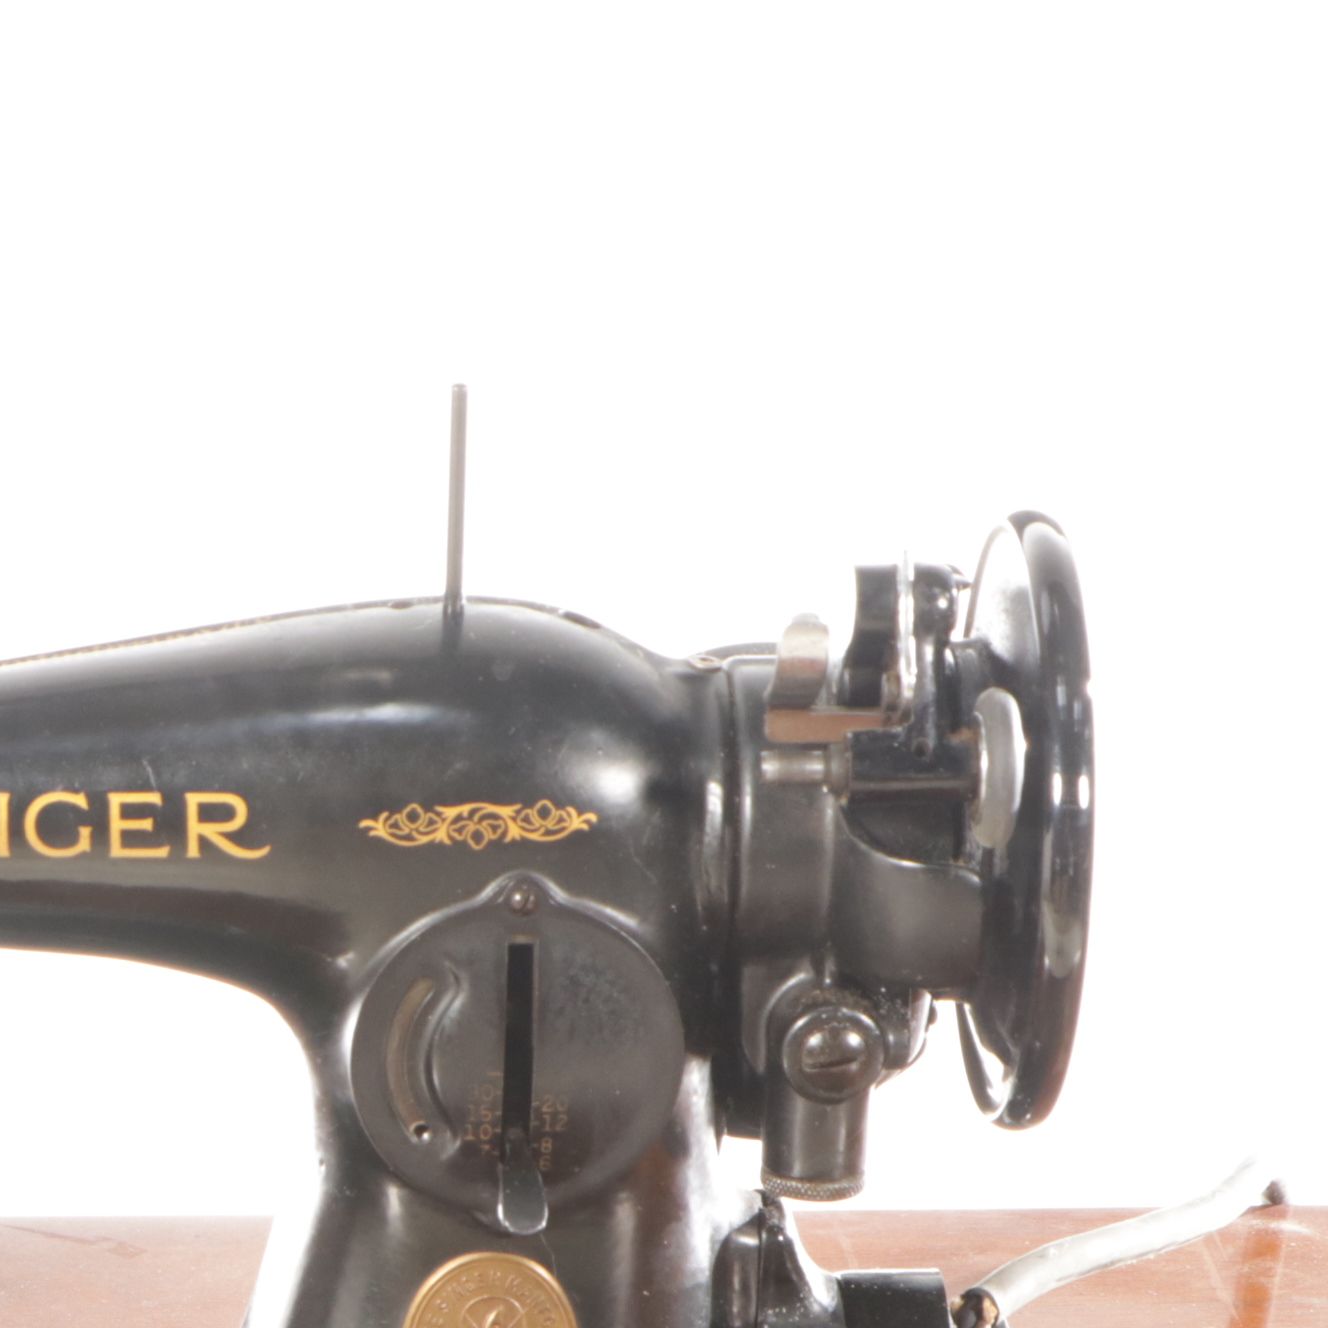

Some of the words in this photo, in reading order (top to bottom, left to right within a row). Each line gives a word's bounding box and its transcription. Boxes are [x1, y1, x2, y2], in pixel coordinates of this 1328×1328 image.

[542, 1114, 568, 1131] 12
[463, 1124, 493, 1140] 10
[540, 1137, 553, 1153] 8
